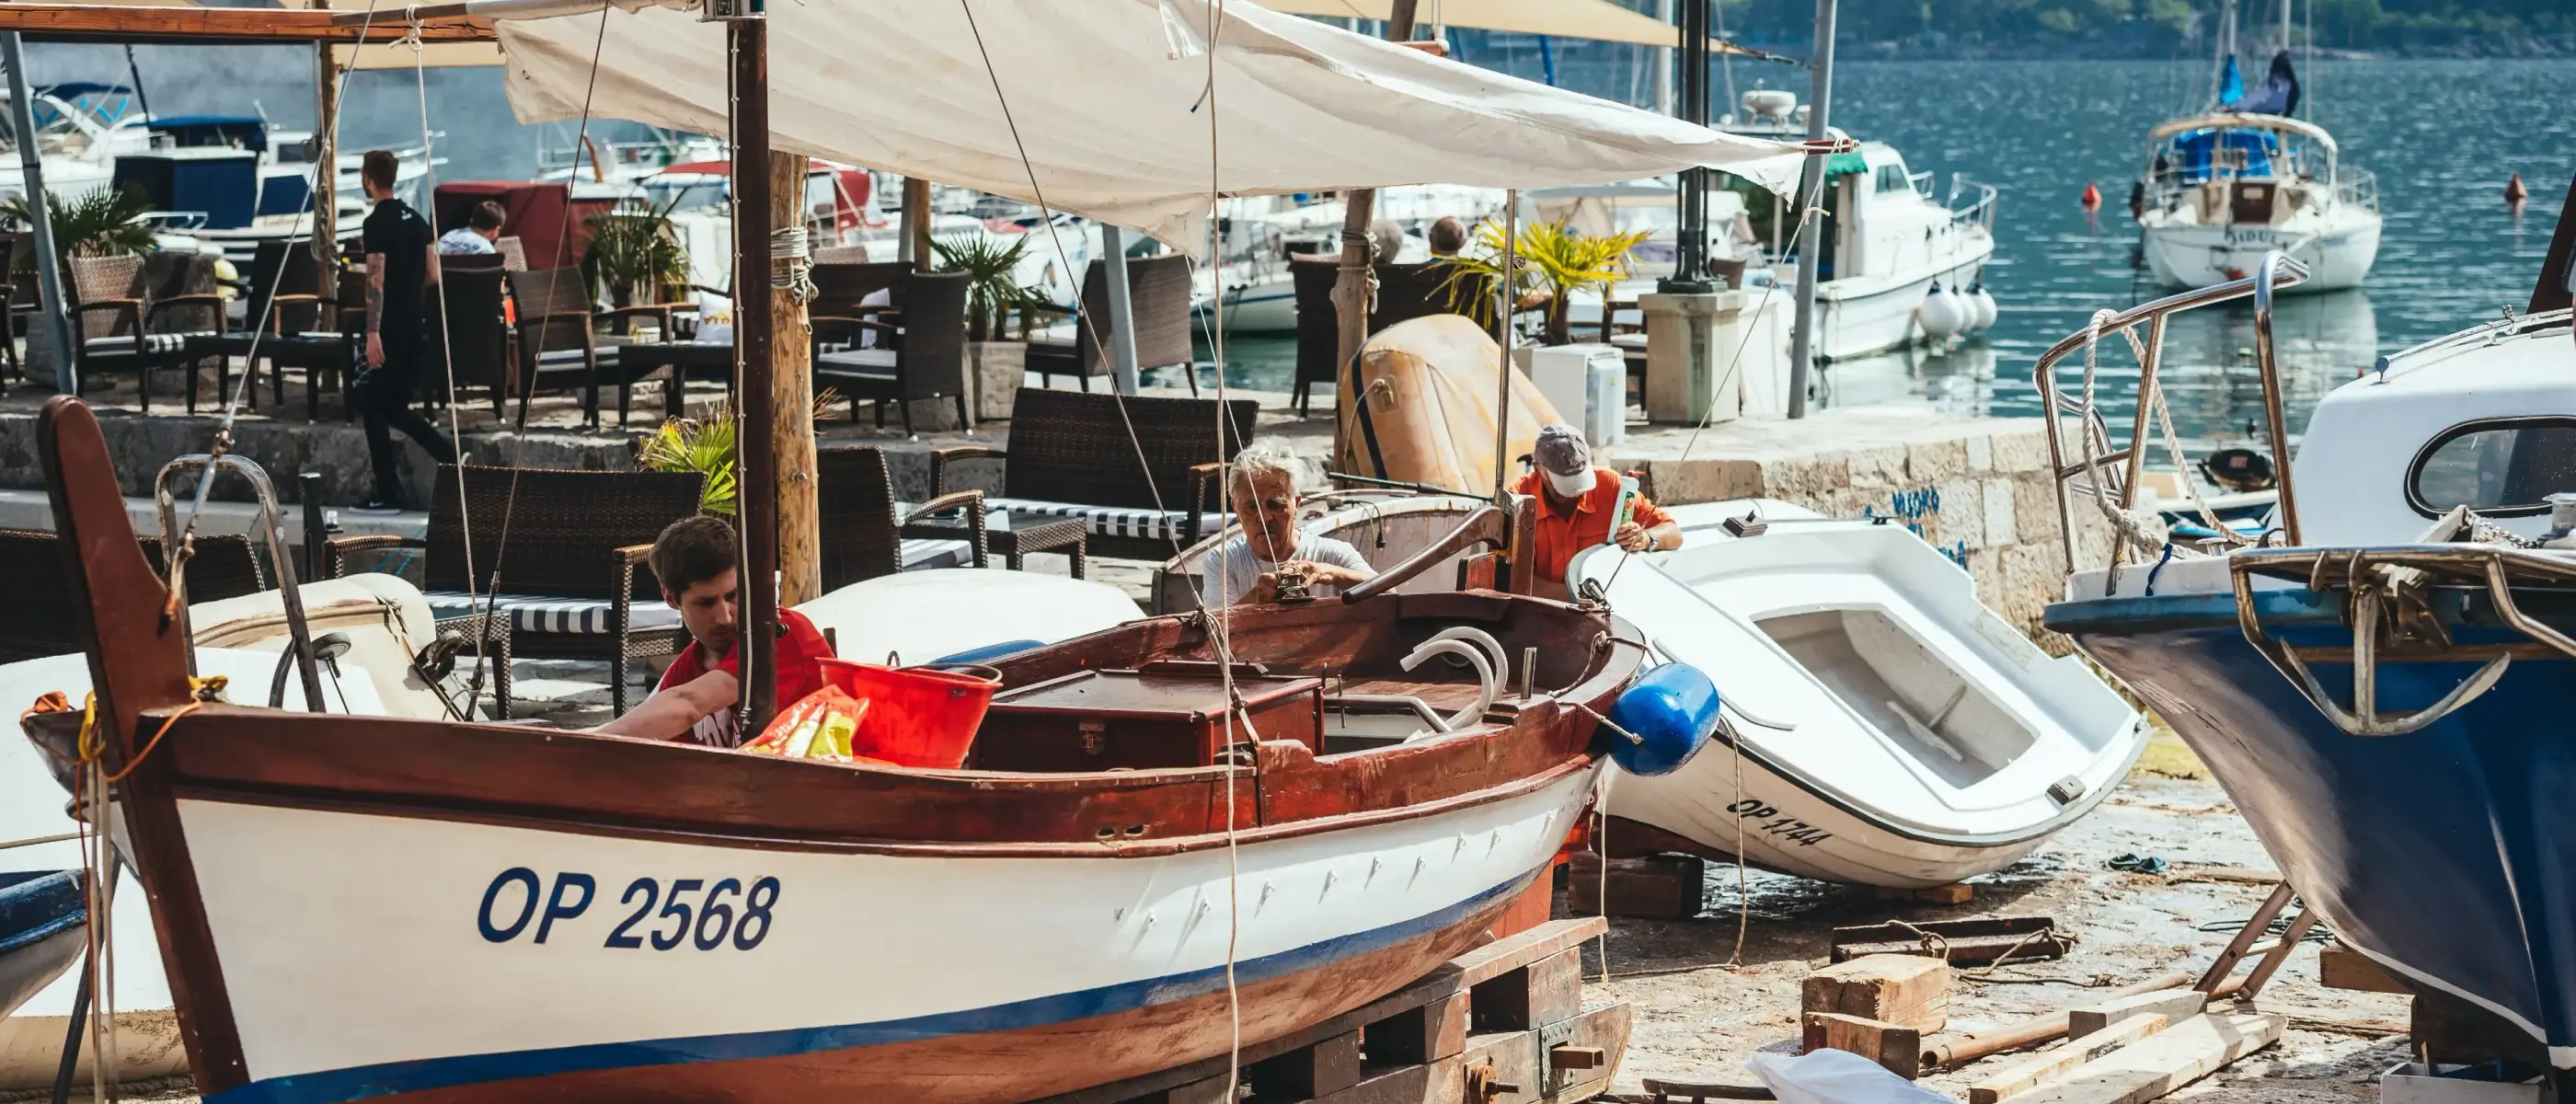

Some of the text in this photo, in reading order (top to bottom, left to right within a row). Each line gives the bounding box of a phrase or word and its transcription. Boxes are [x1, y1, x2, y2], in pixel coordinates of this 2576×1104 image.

[1726, 799, 1834, 846] OP 1744
[477, 866, 781, 951] OP 2568
